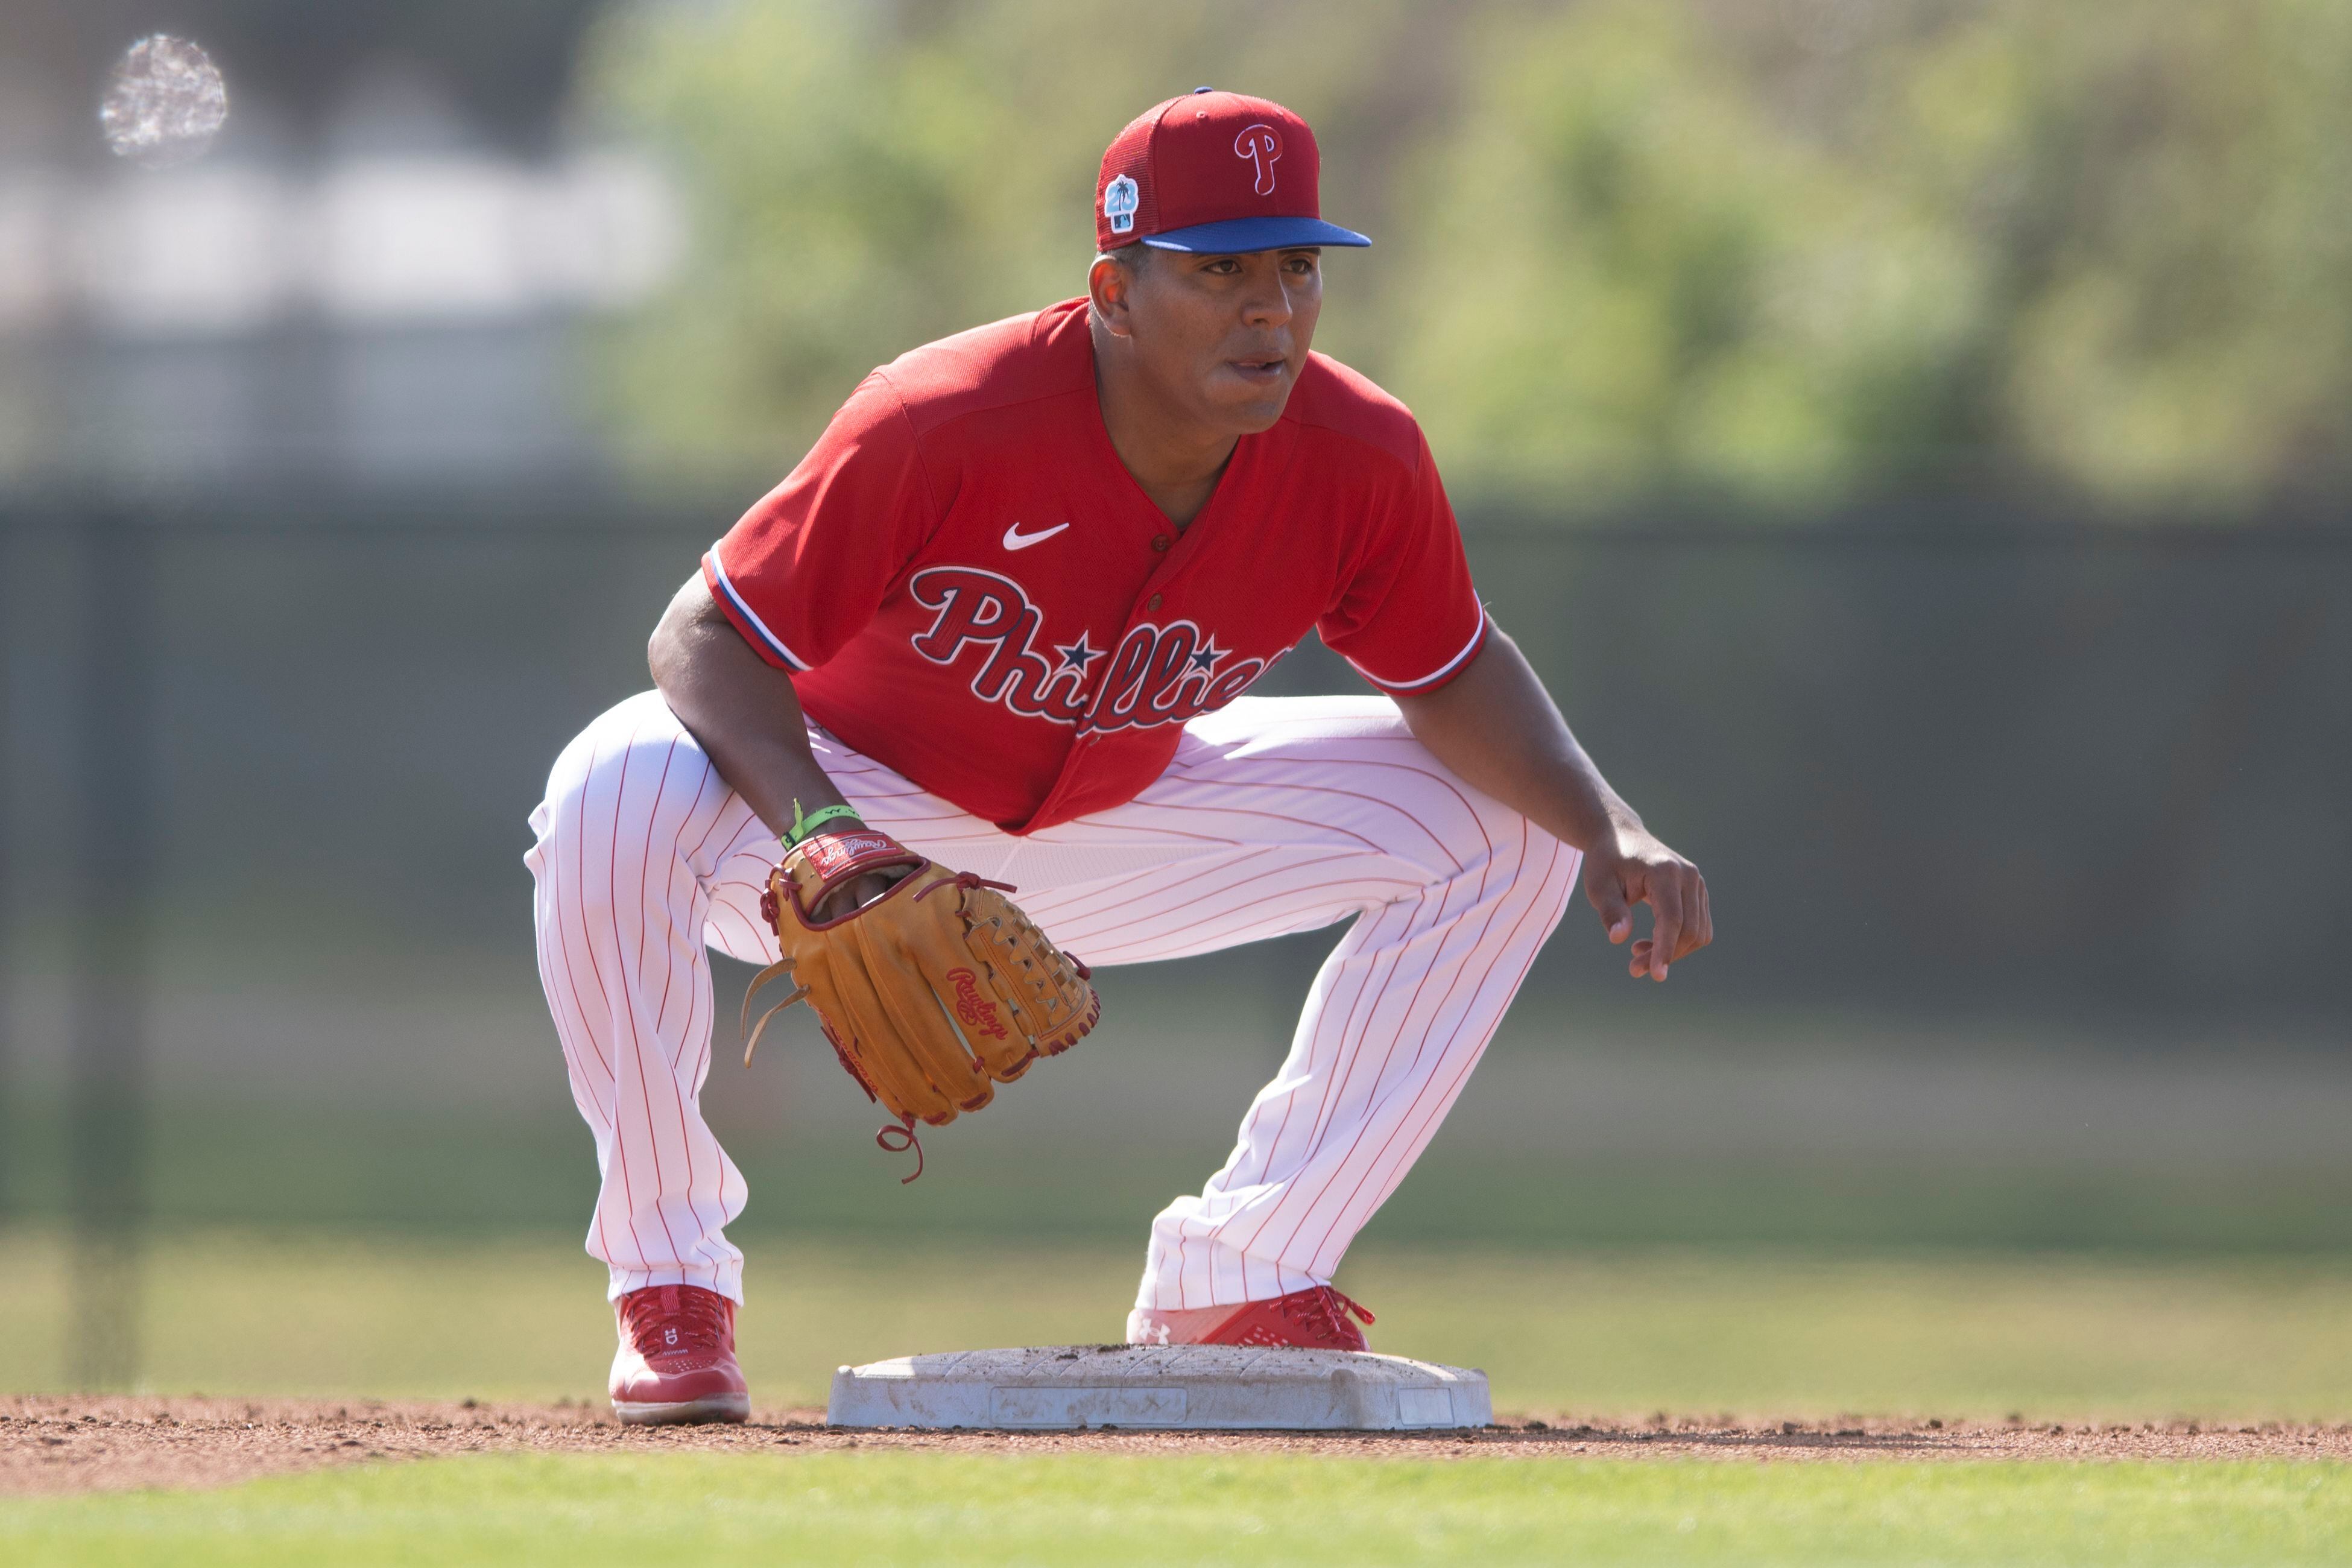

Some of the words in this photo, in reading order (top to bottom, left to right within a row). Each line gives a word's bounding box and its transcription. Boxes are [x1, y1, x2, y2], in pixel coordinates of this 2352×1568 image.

[1234, 124, 1283, 195] P
[1107, 183, 1136, 212] 23
[910, 566, 1294, 739] Phillie
[821, 838, 887, 865] Rawlings
[946, 967, 1008, 1040] Rawlings
